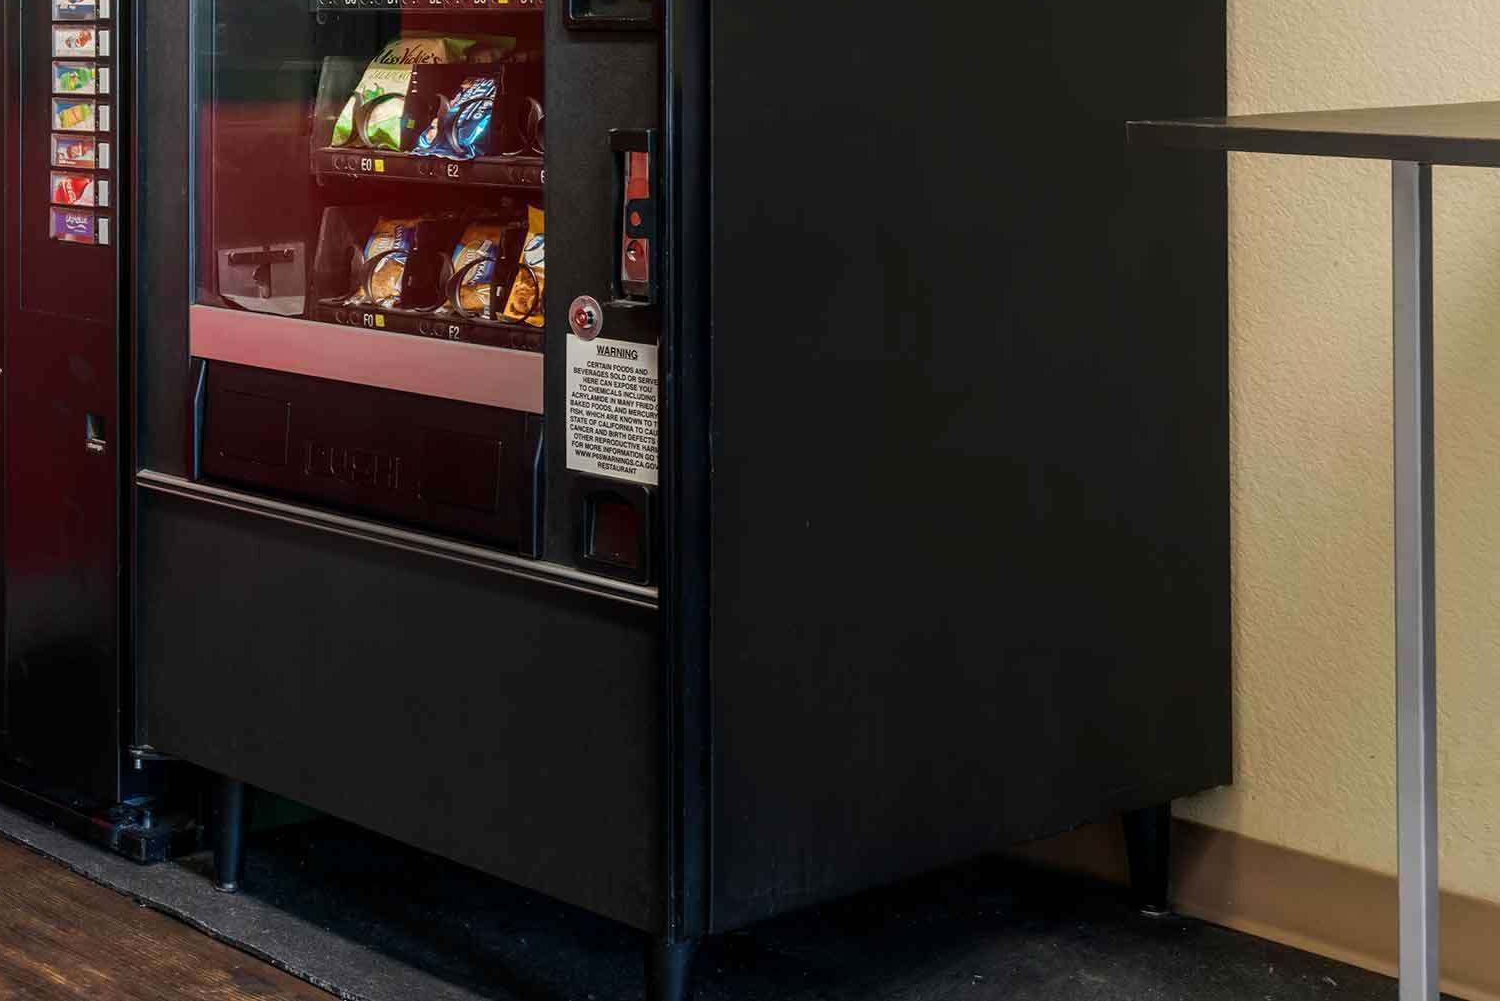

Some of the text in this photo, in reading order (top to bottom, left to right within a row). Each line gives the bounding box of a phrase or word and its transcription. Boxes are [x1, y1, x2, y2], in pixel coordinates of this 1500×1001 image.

[400, 44, 443, 65] Vickie's
[361, 158, 372, 171] E0
[448, 165, 460, 178] E2
[597, 344, 637, 360] WARNING
[573, 367, 608, 378] BEVERAGES
[610, 372, 626, 380] SOLD
[587, 361, 611, 370] CERTAIN
[613, 365, 633, 373] FOODS
[583, 377, 598, 385] HERE
[614, 381, 637, 390] EXPOSE
[588, 386, 622, 396] CHEMICALS
[623, 391, 656, 402] INCLUDING
[570, 400, 590, 408] BAKED
[614, 406, 627, 414] AND
[617, 399, 634, 407] MANY
[636, 402, 653, 410] FRIED
[570, 416, 588, 424] STATE
[598, 421, 633, 432] CALIFORNIA
[585, 410, 605, 418] WHICH
[606, 413, 618, 421] ARE
[620, 416, 642, 425] KNOWN
[570, 424, 656, 444] CANCER AND BIRTH DEFECTS
[574, 432, 593, 441] OTHER
[595, 436, 640, 450] REPRODUCTIVE
[572, 440, 655, 461] FOR MORE INFORMATION GO
[598, 461, 637, 474] RESTAURANT
